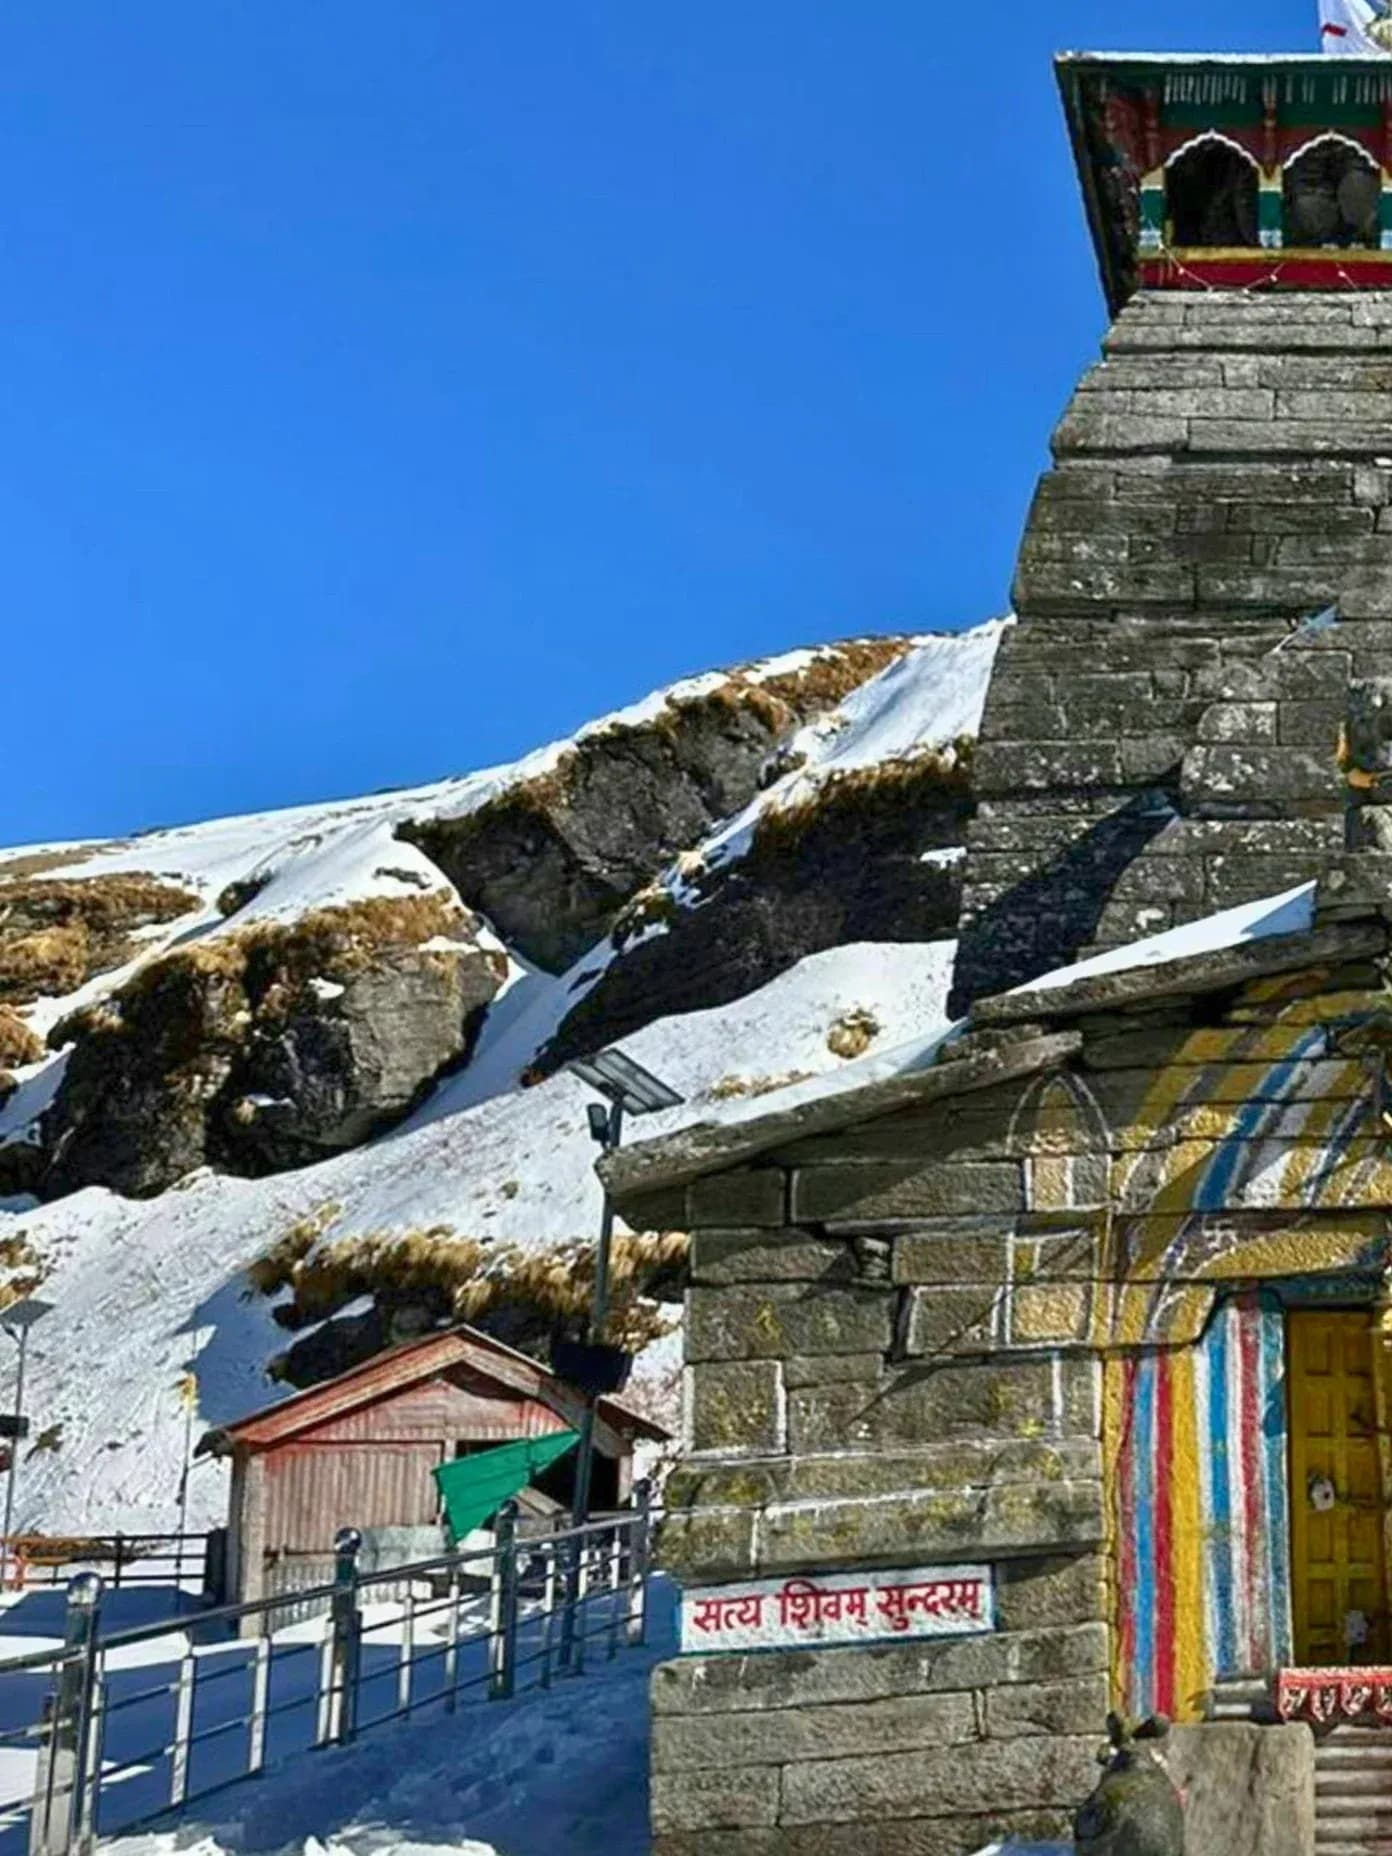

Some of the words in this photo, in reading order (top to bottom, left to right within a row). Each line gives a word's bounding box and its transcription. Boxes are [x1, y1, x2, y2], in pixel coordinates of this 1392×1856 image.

[693, 1594, 766, 1632] सत्य
[776, 1578, 869, 1630] शिवम्
[876, 1578, 984, 1631] सुन्दरम्
